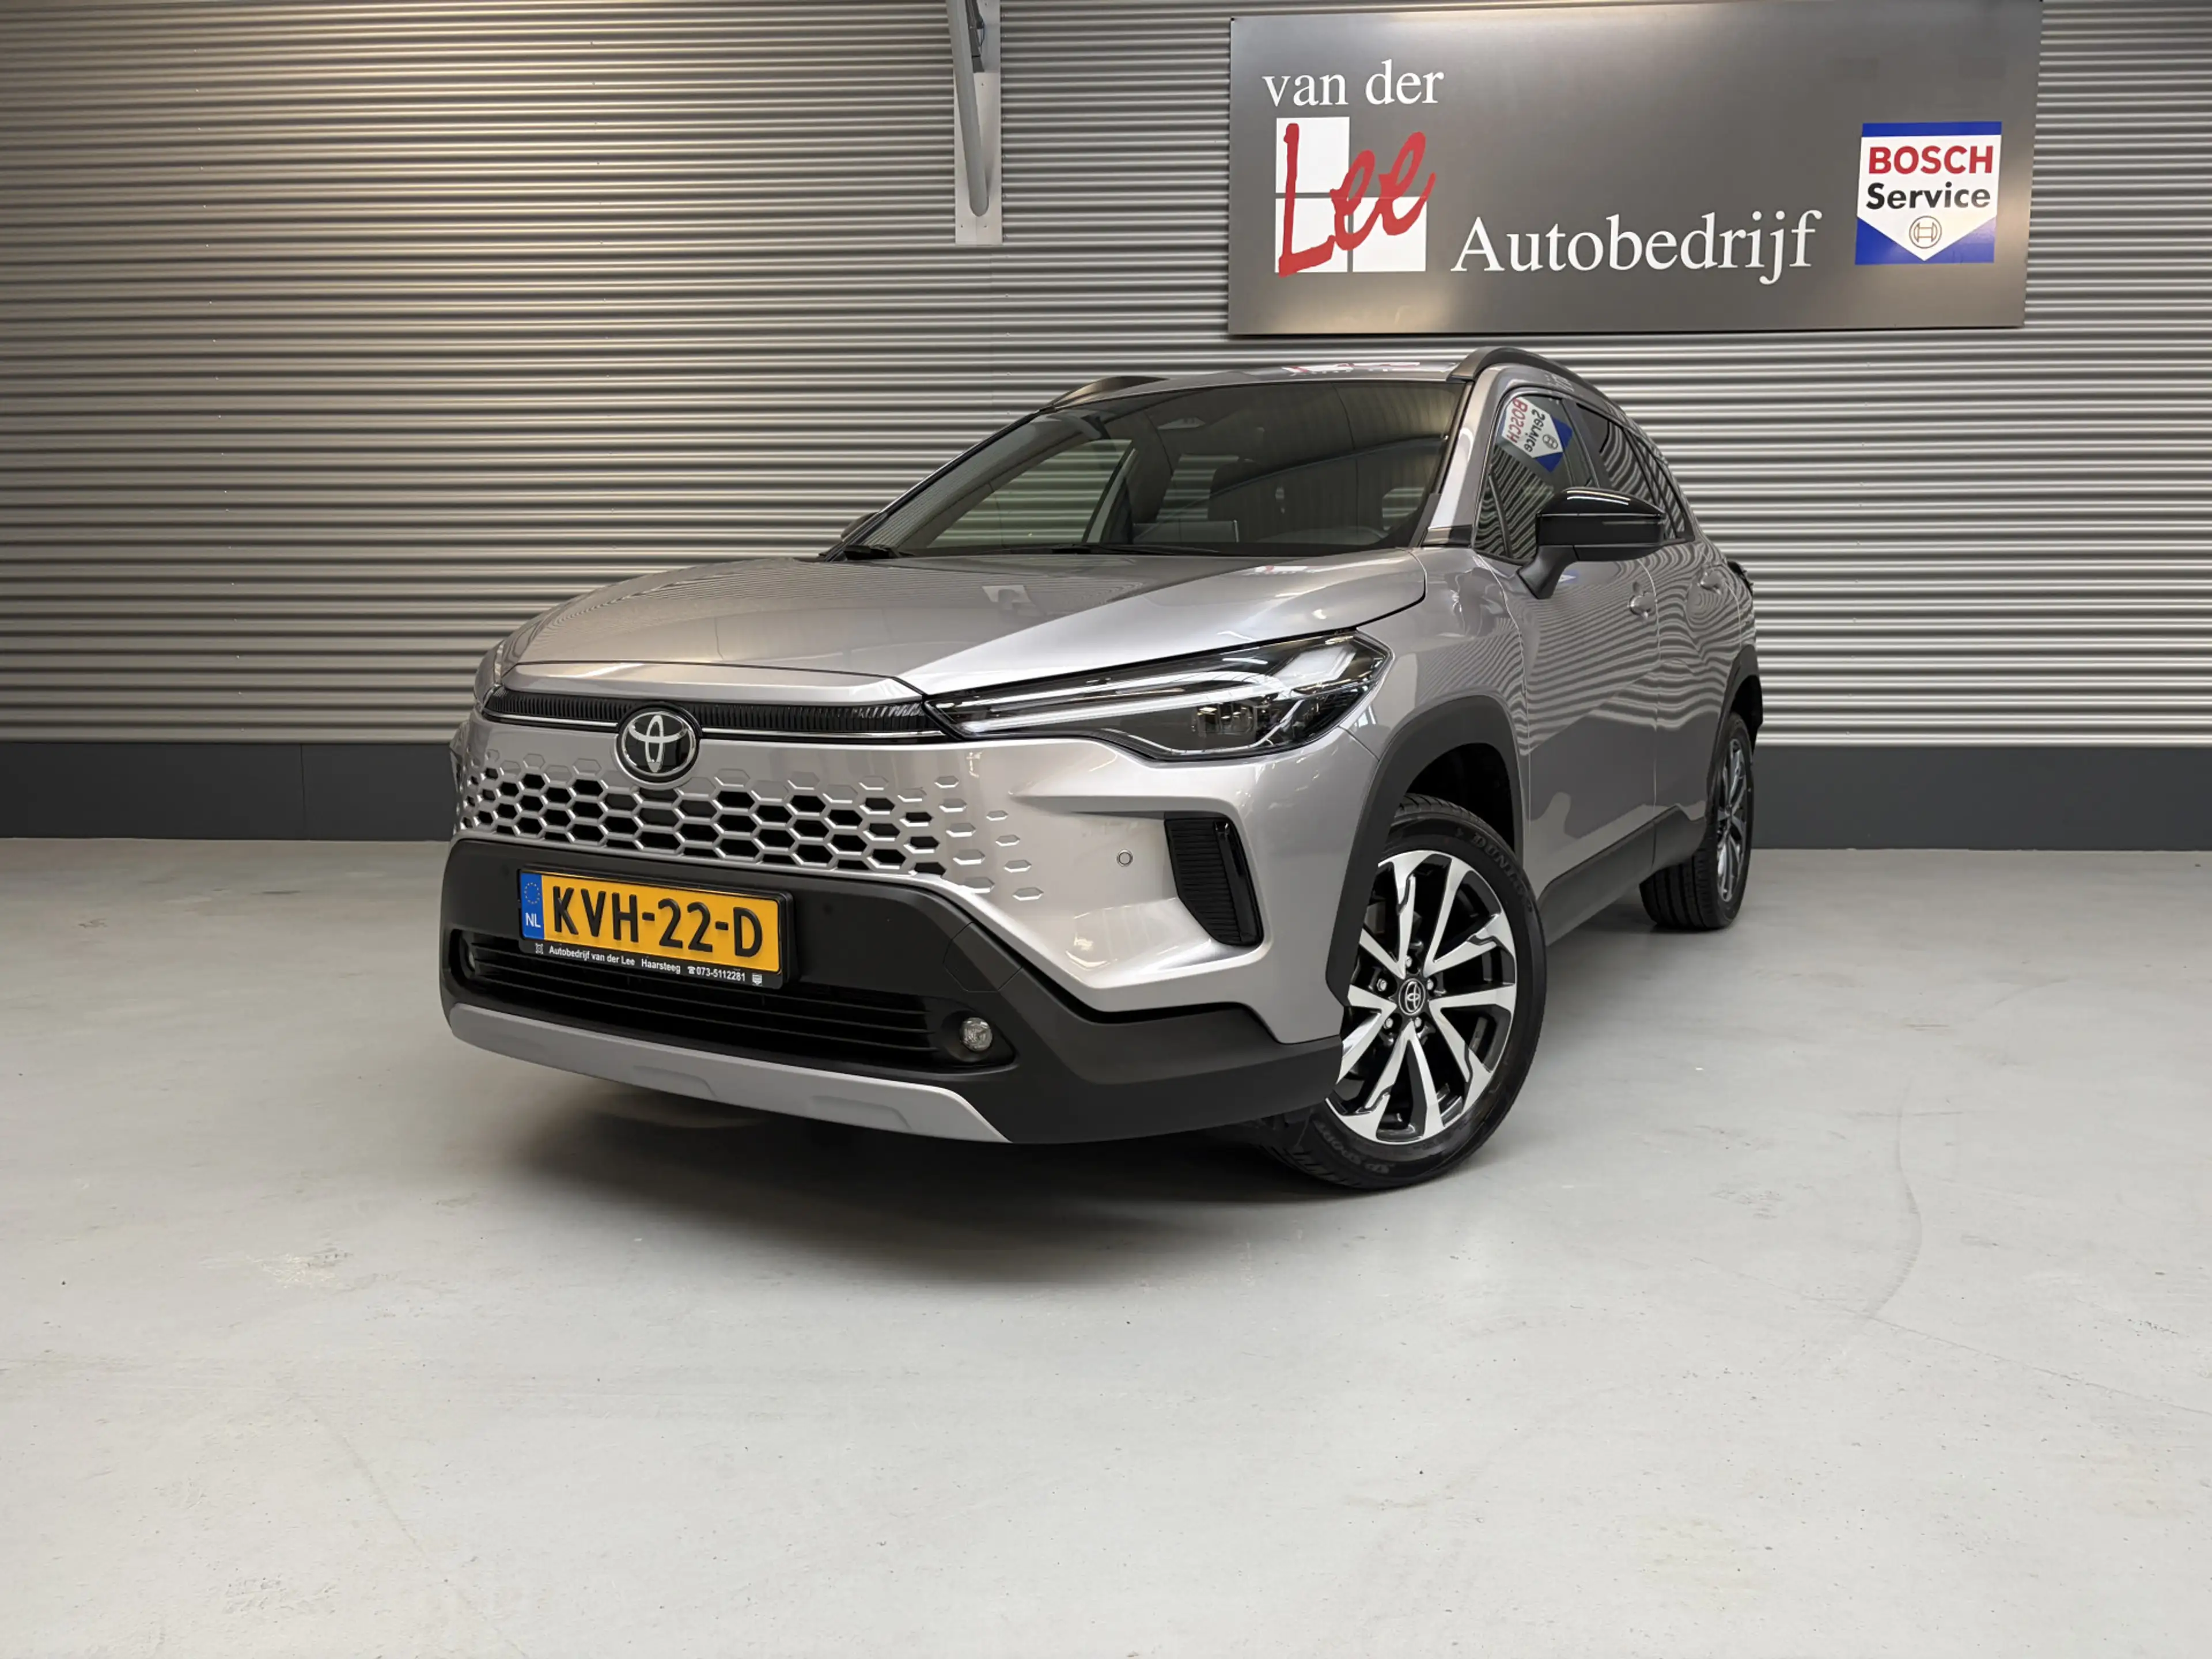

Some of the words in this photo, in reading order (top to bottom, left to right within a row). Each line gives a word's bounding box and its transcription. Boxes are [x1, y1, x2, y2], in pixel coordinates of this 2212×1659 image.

[1262, 74, 1349, 107] van
[1365, 58, 1445, 105] der
[1869, 145, 1994, 175] BOSCH
[1278, 123, 1437, 278] Lee
[1866, 181, 1991, 210] Service
[1450, 210, 1823, 285] Autobedrijf
[525, 912, 541, 929] NL
[552, 886, 763, 958] KVH-22-D
[549, 945, 590, 961] Autobedrijf
[591, 953, 605, 962] van
[607, 954, 620, 964] der
[621, 956, 635, 966] Lee
[641, 959, 681, 974] Haarsteeg
